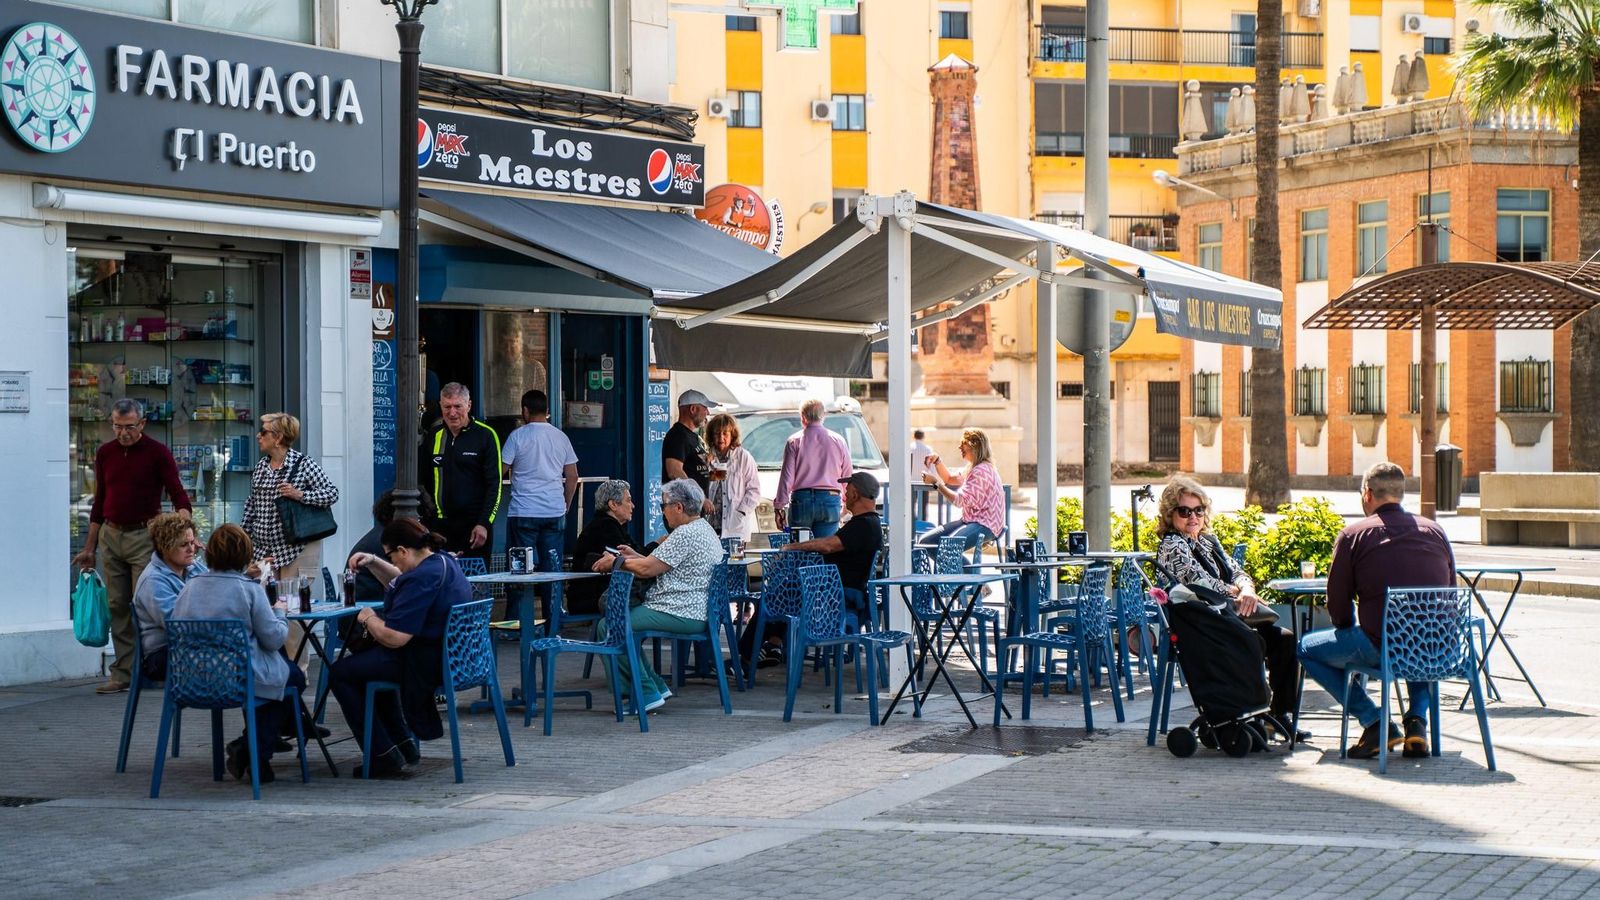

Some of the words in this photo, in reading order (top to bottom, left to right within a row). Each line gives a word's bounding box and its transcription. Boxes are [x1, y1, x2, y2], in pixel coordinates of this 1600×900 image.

[116, 44, 364, 125] FARMACIA
[437, 123, 457, 133] pepsi
[218, 132, 316, 173] Puerto
[434, 132, 469, 155] MAX
[531, 128, 593, 162] Los
[435, 152, 459, 165] zero
[675, 153, 691, 163] pepsi
[478, 154, 642, 198] Maestres
[673, 161, 702, 182] MAX
[674, 180, 693, 191] zero
[701, 219, 766, 247] uzcampo
[1186, 297, 1200, 328] BAR
[1203, 300, 1215, 331] LOS
[1218, 303, 1251, 336] MAESTRES
